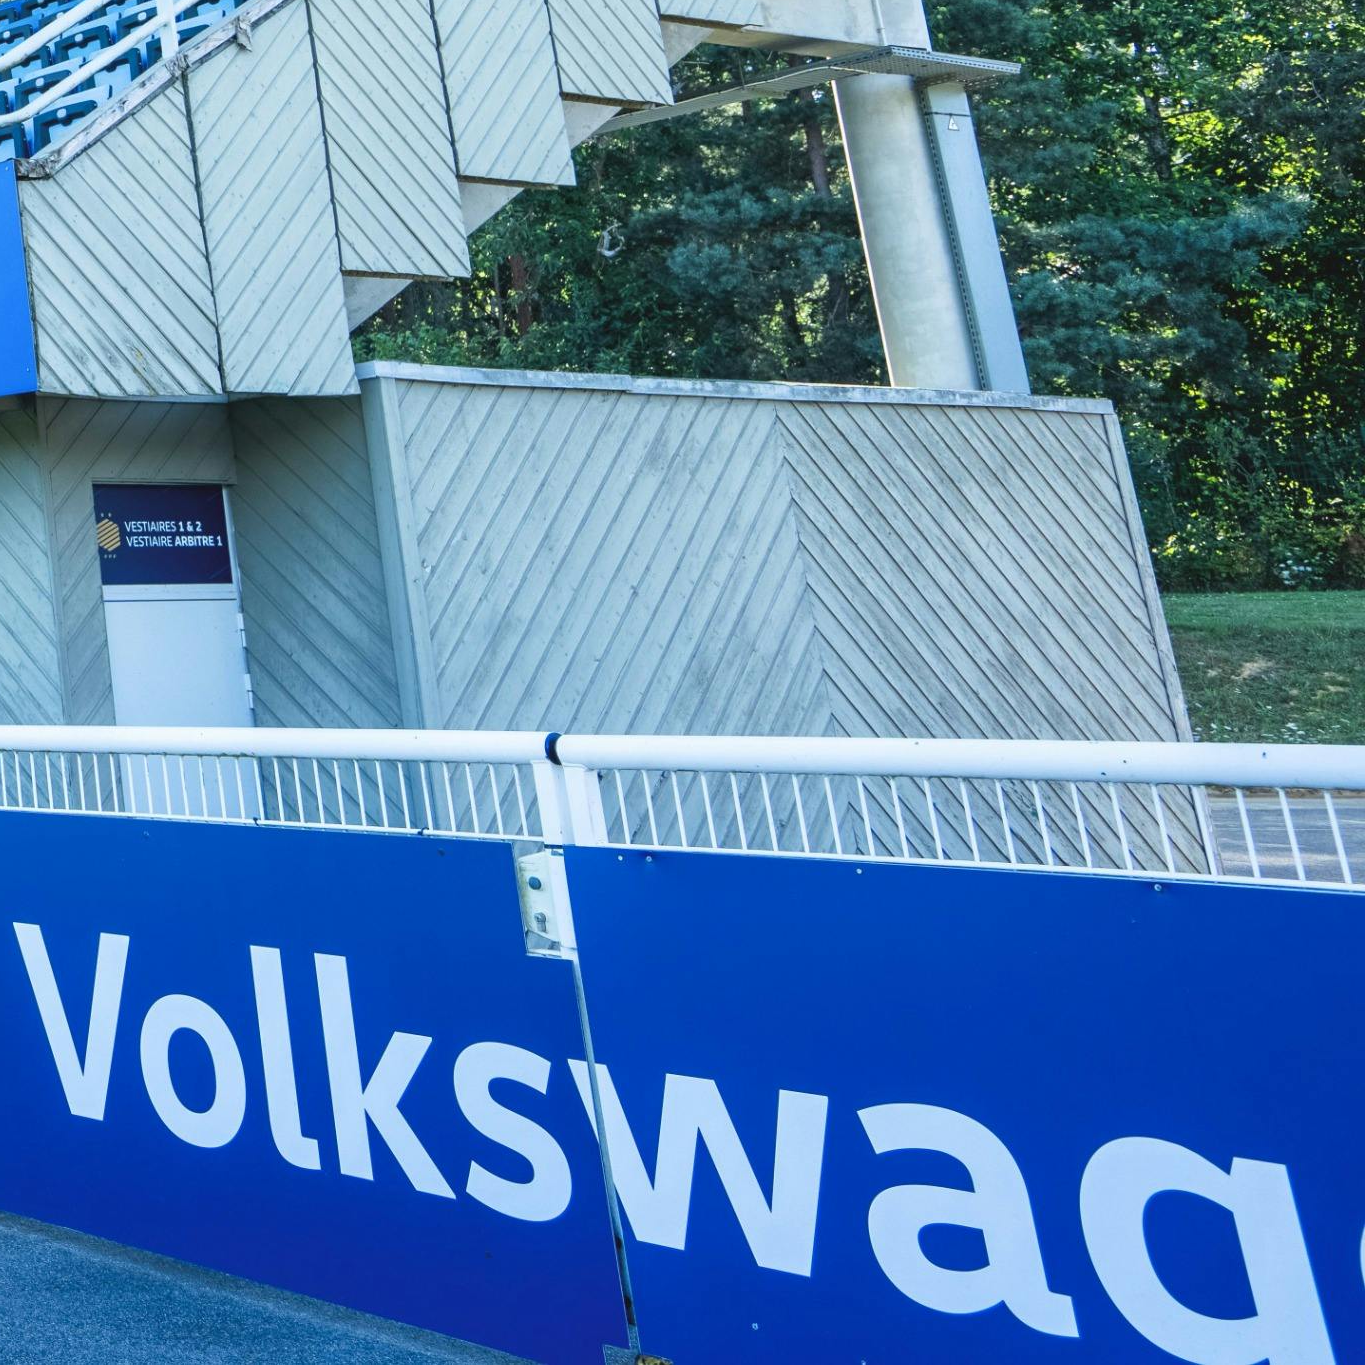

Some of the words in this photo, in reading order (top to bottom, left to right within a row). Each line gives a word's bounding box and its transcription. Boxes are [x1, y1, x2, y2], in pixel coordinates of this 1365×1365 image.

[124, 521, 176, 532] VESTIAIRES
[178, 521, 185, 532] 1
[186, 521, 194, 532] &
[195, 521, 202, 532] 2
[126, 535, 173, 547] VESTIAIRE
[174, 535, 215, 547] ARBITRE
[217, 535, 223, 546] 1
[12, 921, 1365, 1365] Volkswag
